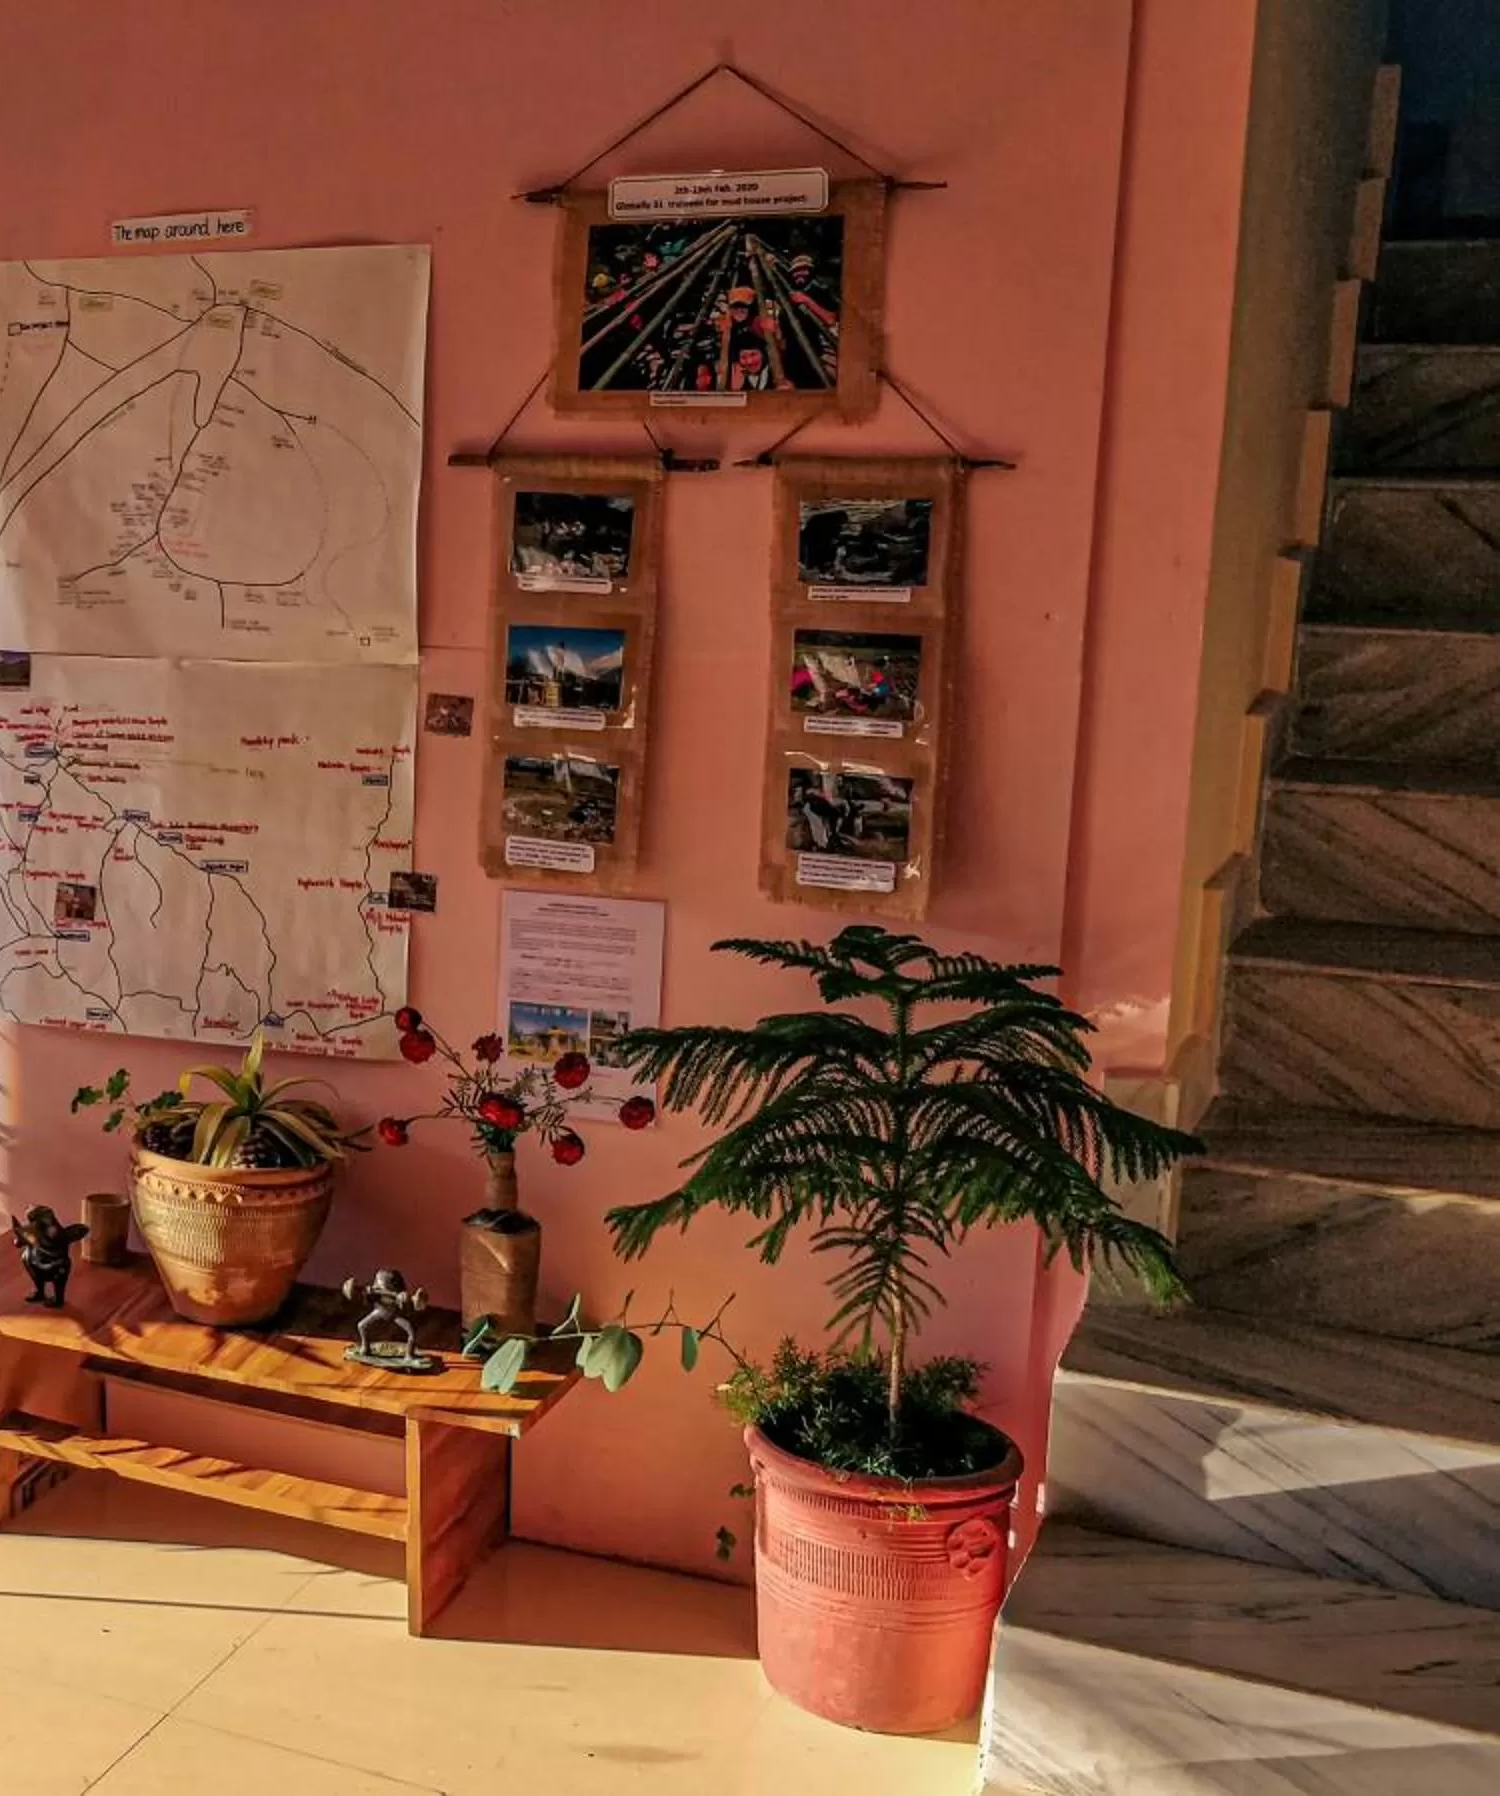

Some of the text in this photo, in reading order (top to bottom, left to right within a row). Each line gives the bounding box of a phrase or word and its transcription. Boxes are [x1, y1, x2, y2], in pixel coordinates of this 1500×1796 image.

[112, 213, 245, 242] The map around here
